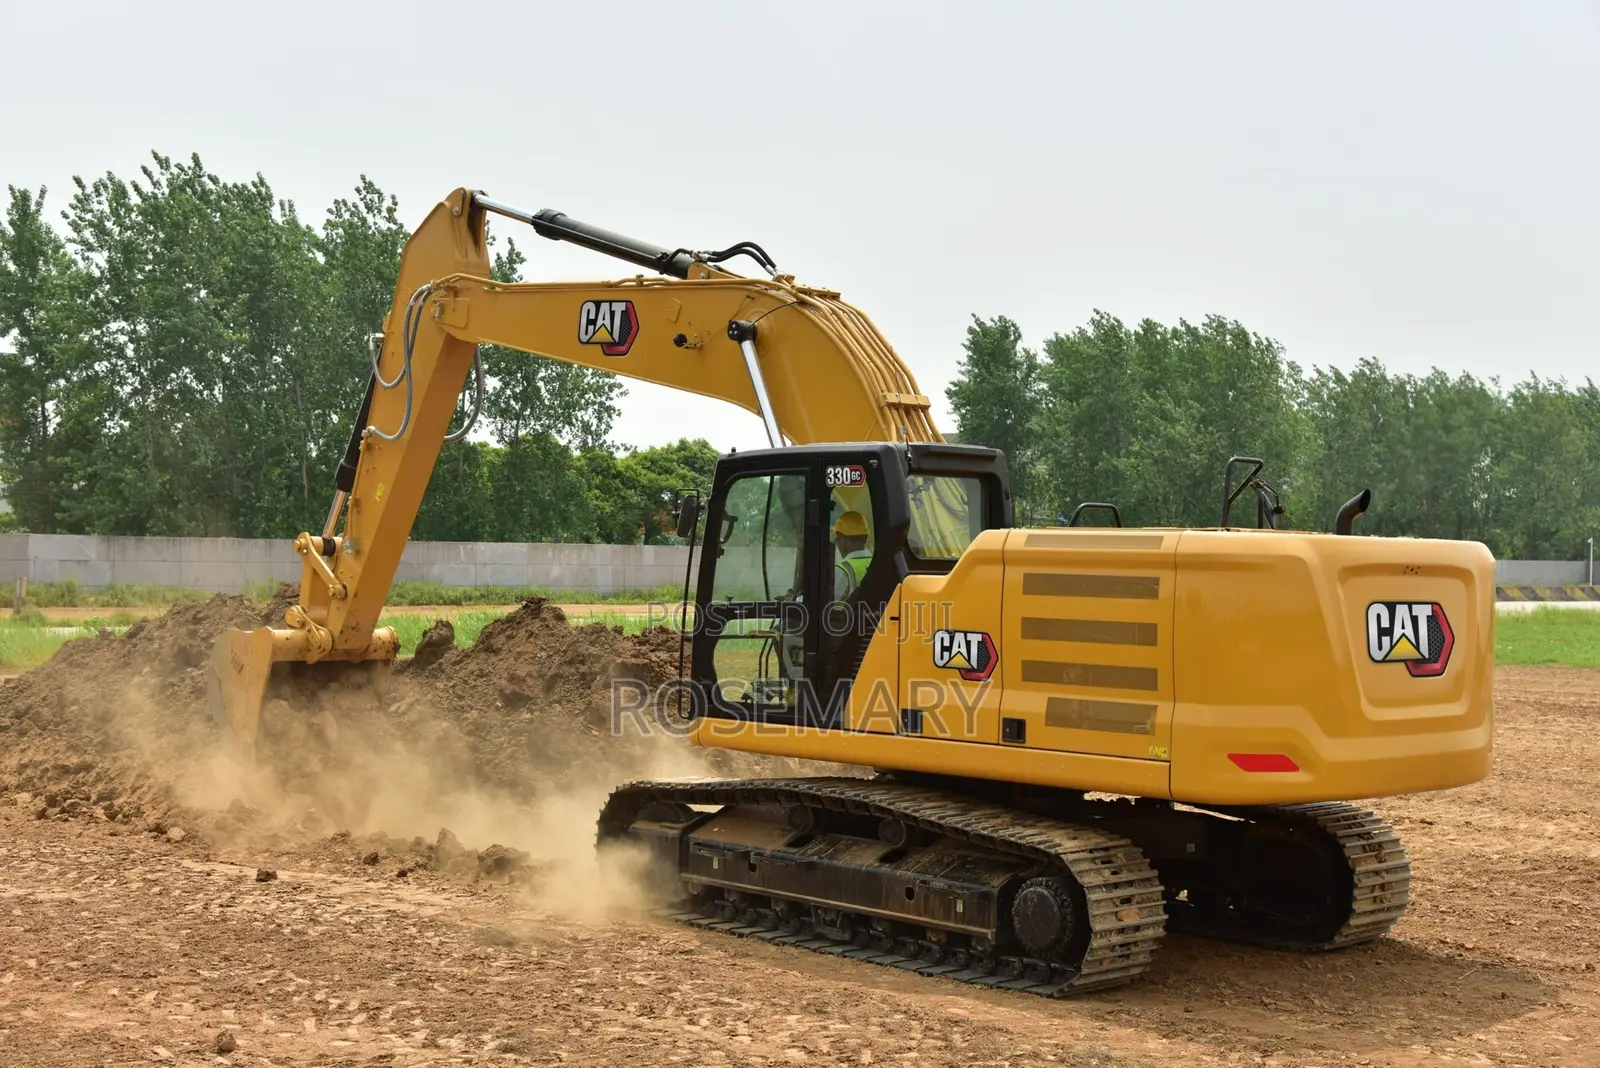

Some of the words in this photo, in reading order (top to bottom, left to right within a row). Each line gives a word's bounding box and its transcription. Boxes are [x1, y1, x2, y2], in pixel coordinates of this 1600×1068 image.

[579, 301, 626, 343] CAT
[827, 467, 851, 485] 330
[851, 471, 861, 481] GC
[934, 630, 982, 669] CAT
[1367, 603, 1432, 660] CAT
